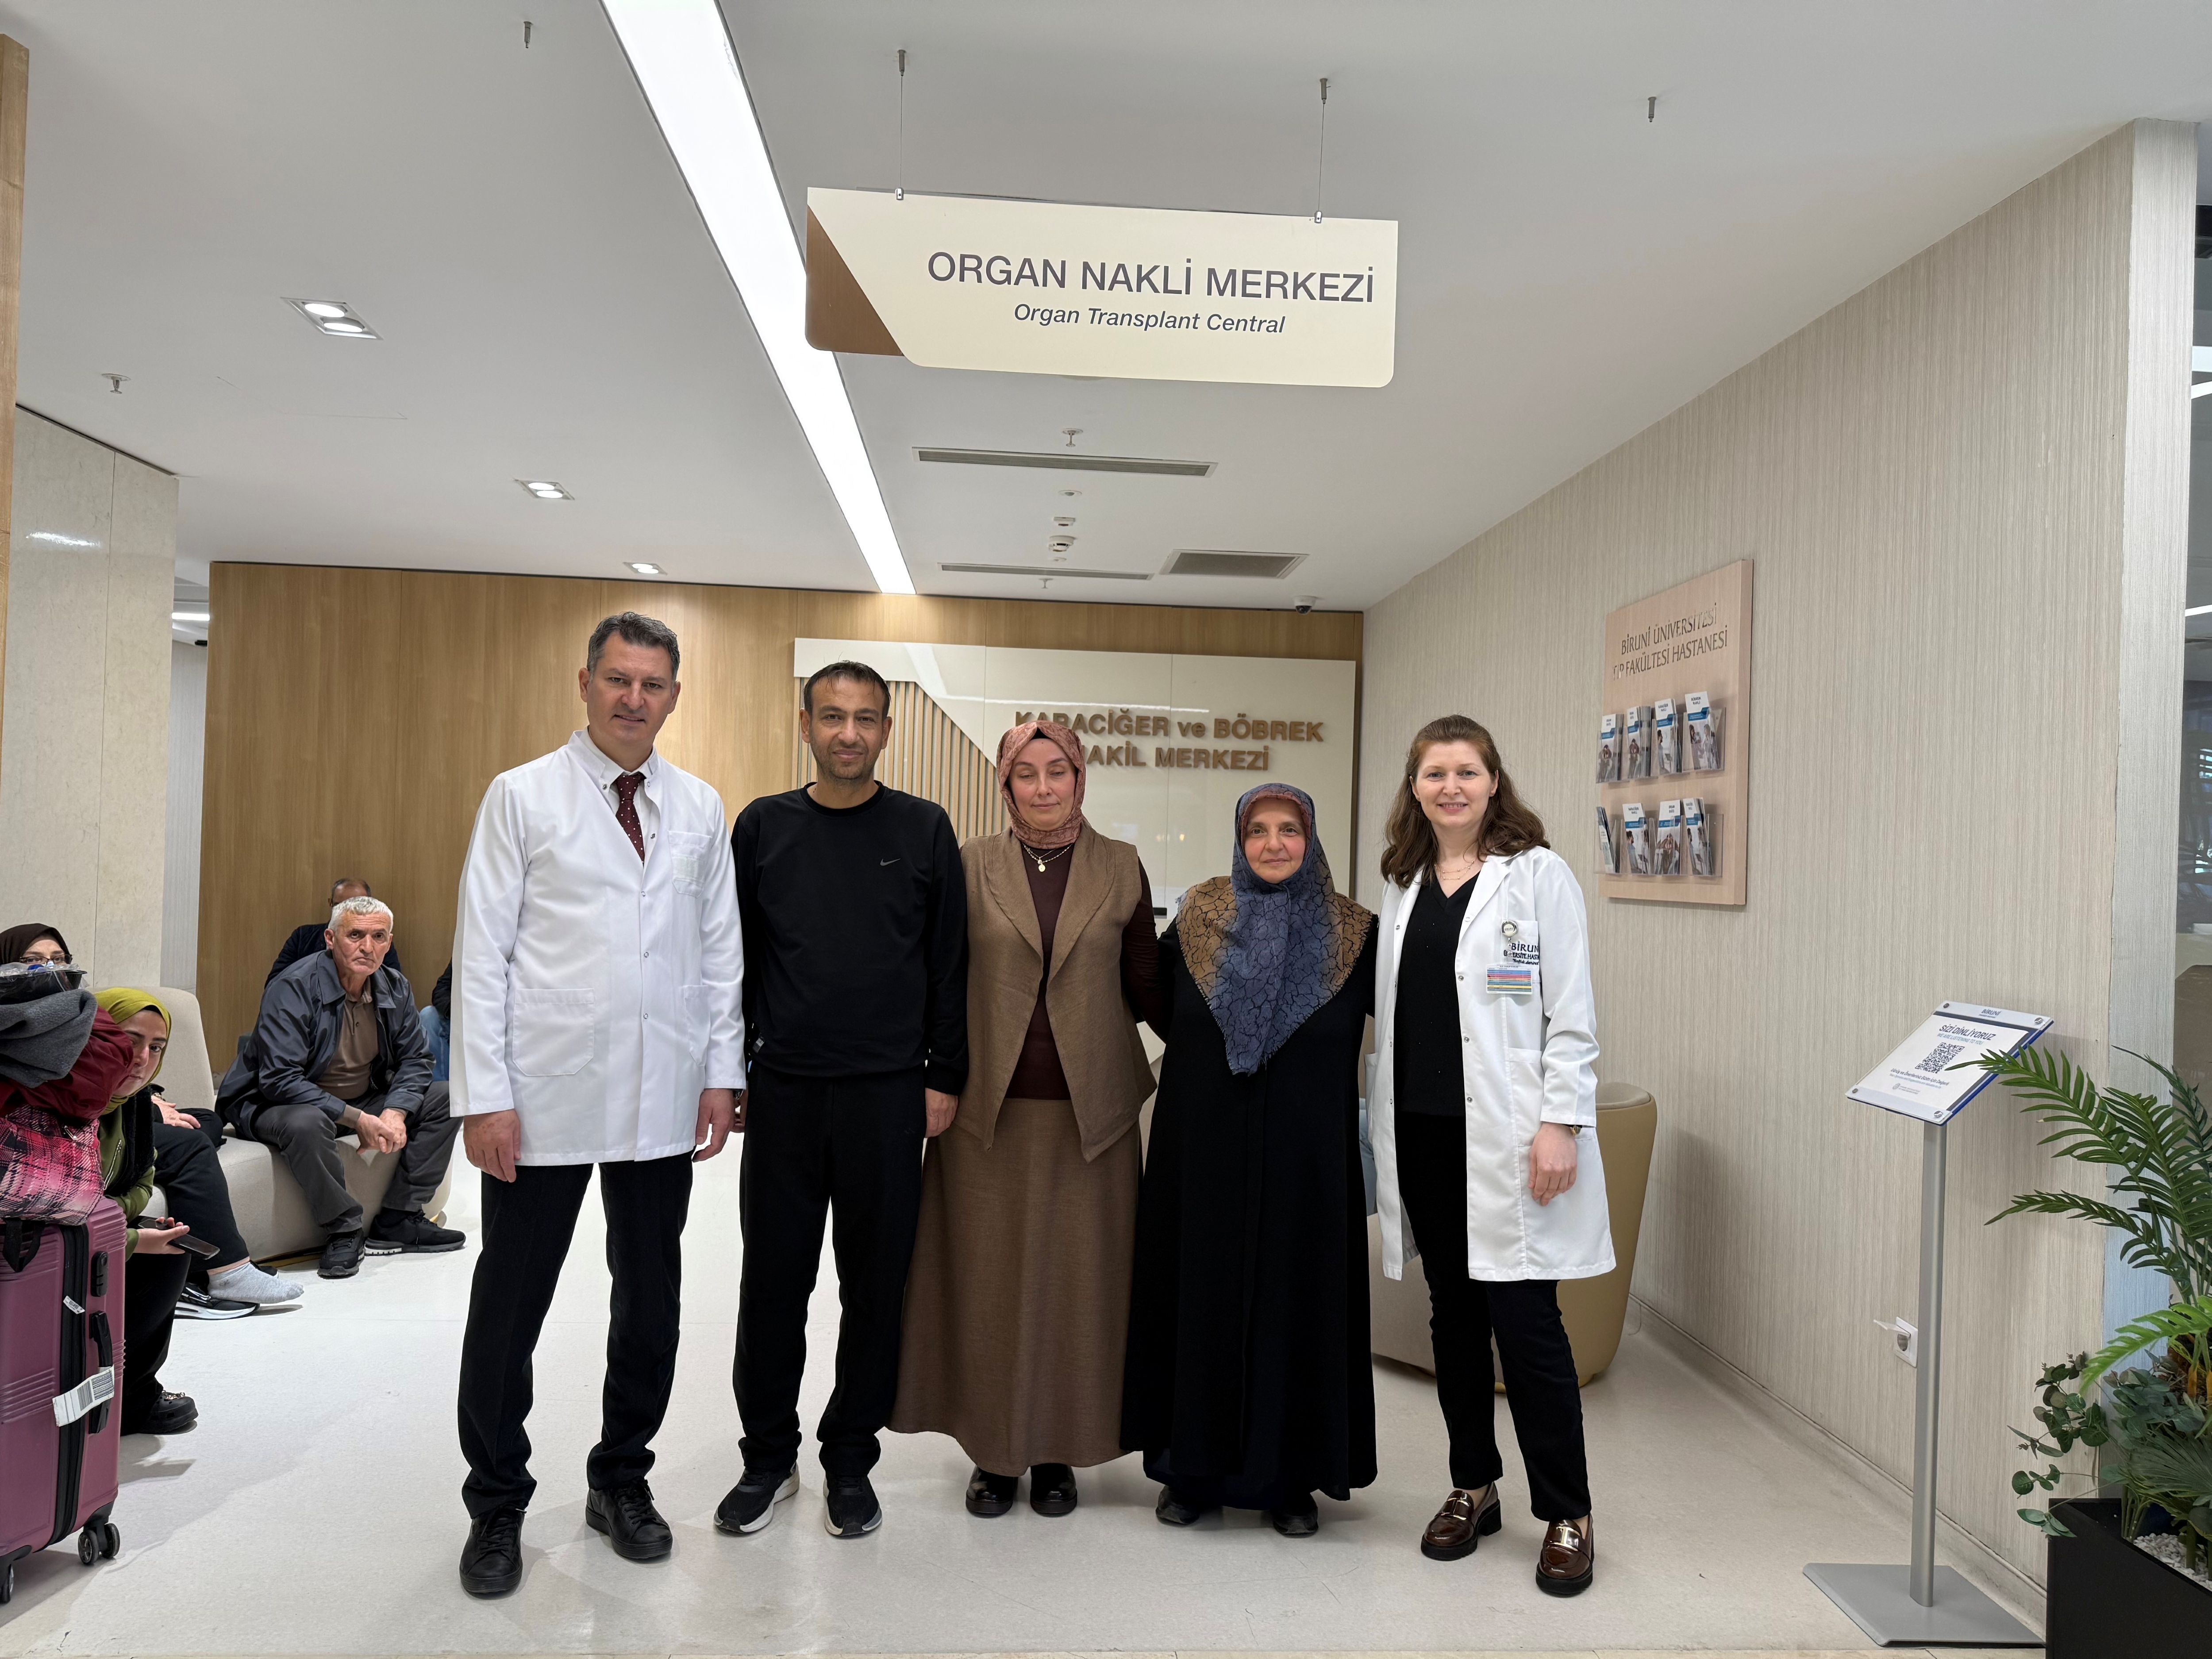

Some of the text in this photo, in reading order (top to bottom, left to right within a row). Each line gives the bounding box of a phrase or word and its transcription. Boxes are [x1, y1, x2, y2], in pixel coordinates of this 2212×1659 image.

[927, 251, 1373, 303] ORGAN NAKLİ MERKEZİ
[1014, 303, 1286, 333] Organ Transplant Central
[1621, 602, 1717, 655] BİRUNİ ÜNİVERSİTESİ
[1626, 643, 1670, 677] FAKÜLTESİ
[1672, 624, 1728, 663] HASTANESİ
[1177, 721, 1206, 737] ve
[1213, 713, 1324, 742] BÖBREK
[1083, 740, 1269, 771] AKİL MERKEZİ
[1939, 1024, 1997, 1040] SİZİ DİNLİYORUZ
